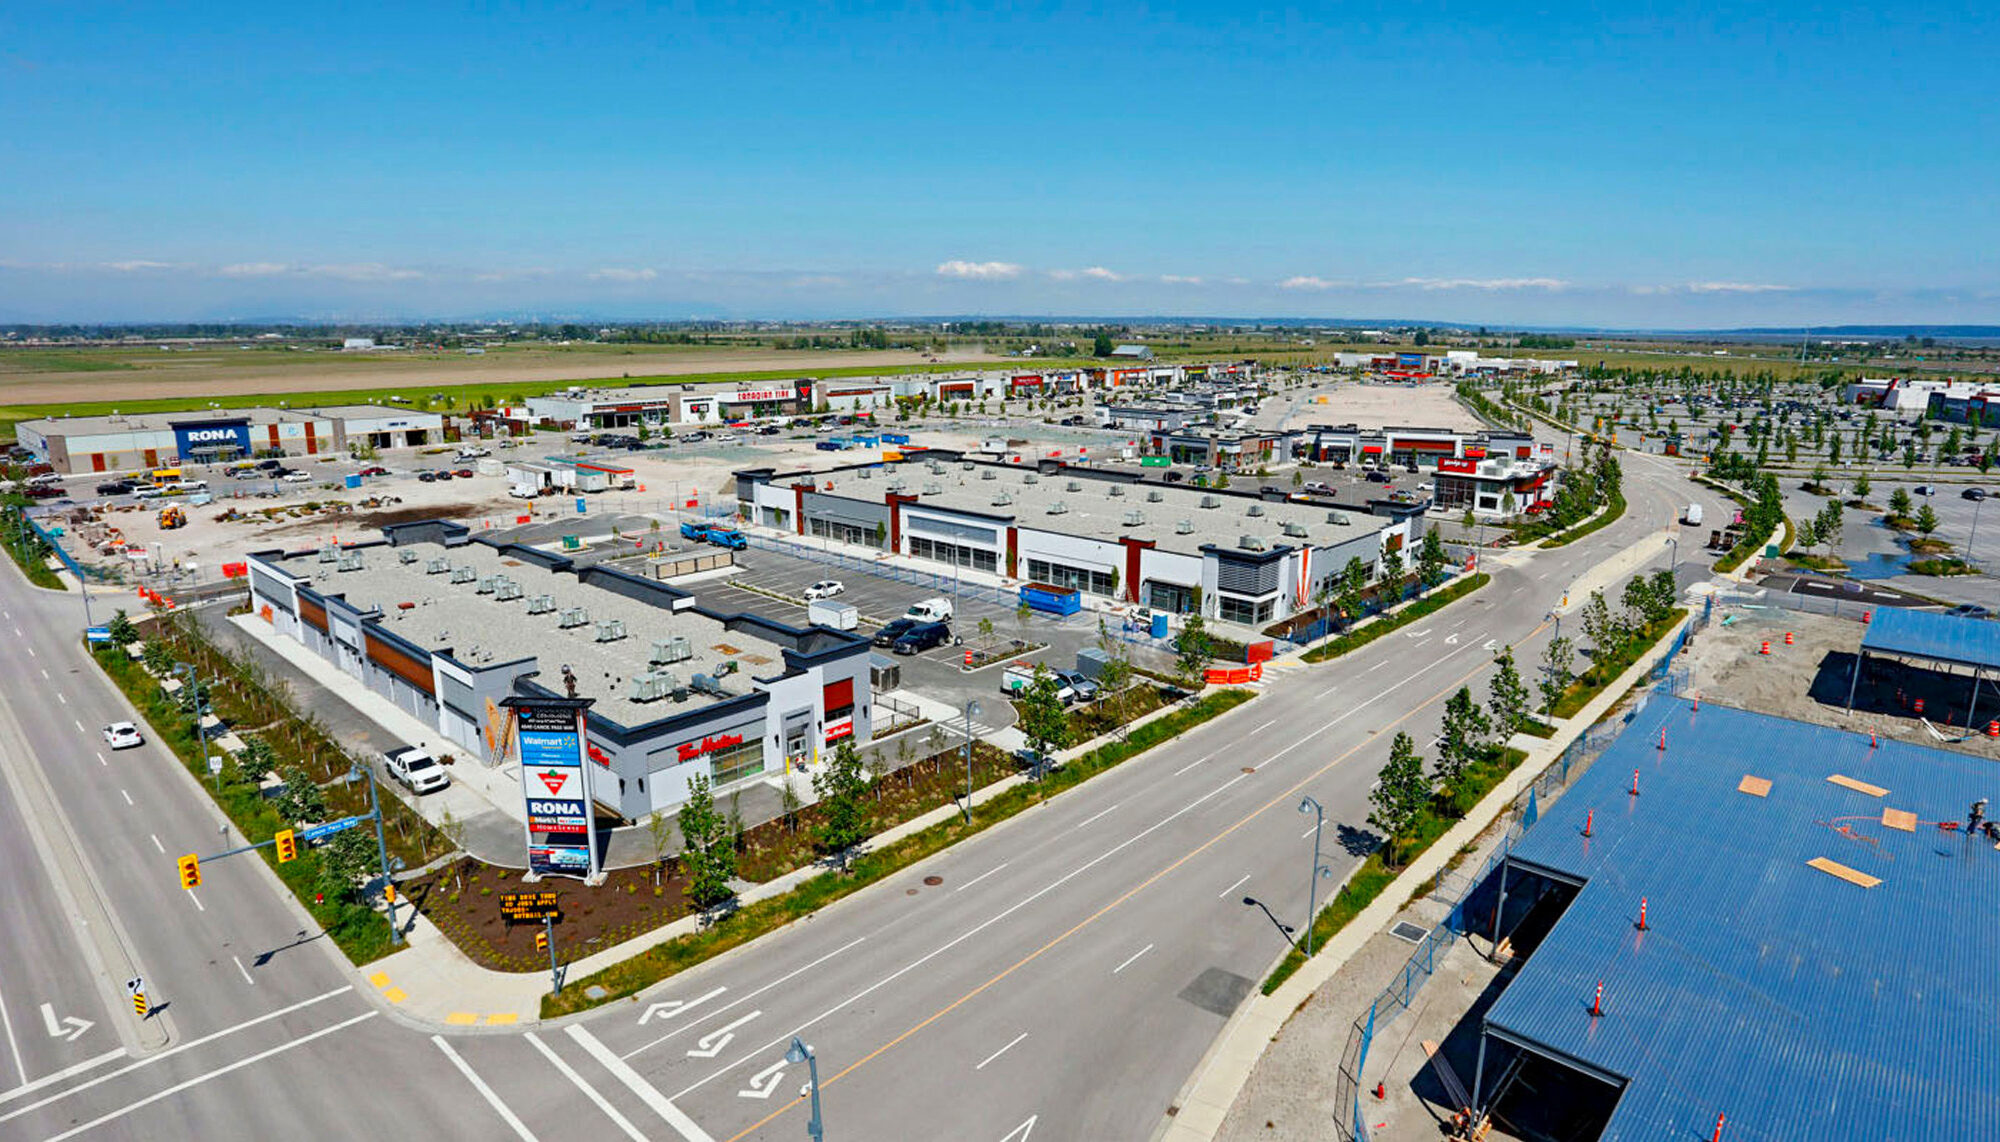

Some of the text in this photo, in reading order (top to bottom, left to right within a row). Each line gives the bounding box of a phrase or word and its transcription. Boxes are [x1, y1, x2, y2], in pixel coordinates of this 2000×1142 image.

[188, 429, 238, 441] RONA
[523, 736, 562, 746] Walmart
[531, 802, 581, 814] RONA
